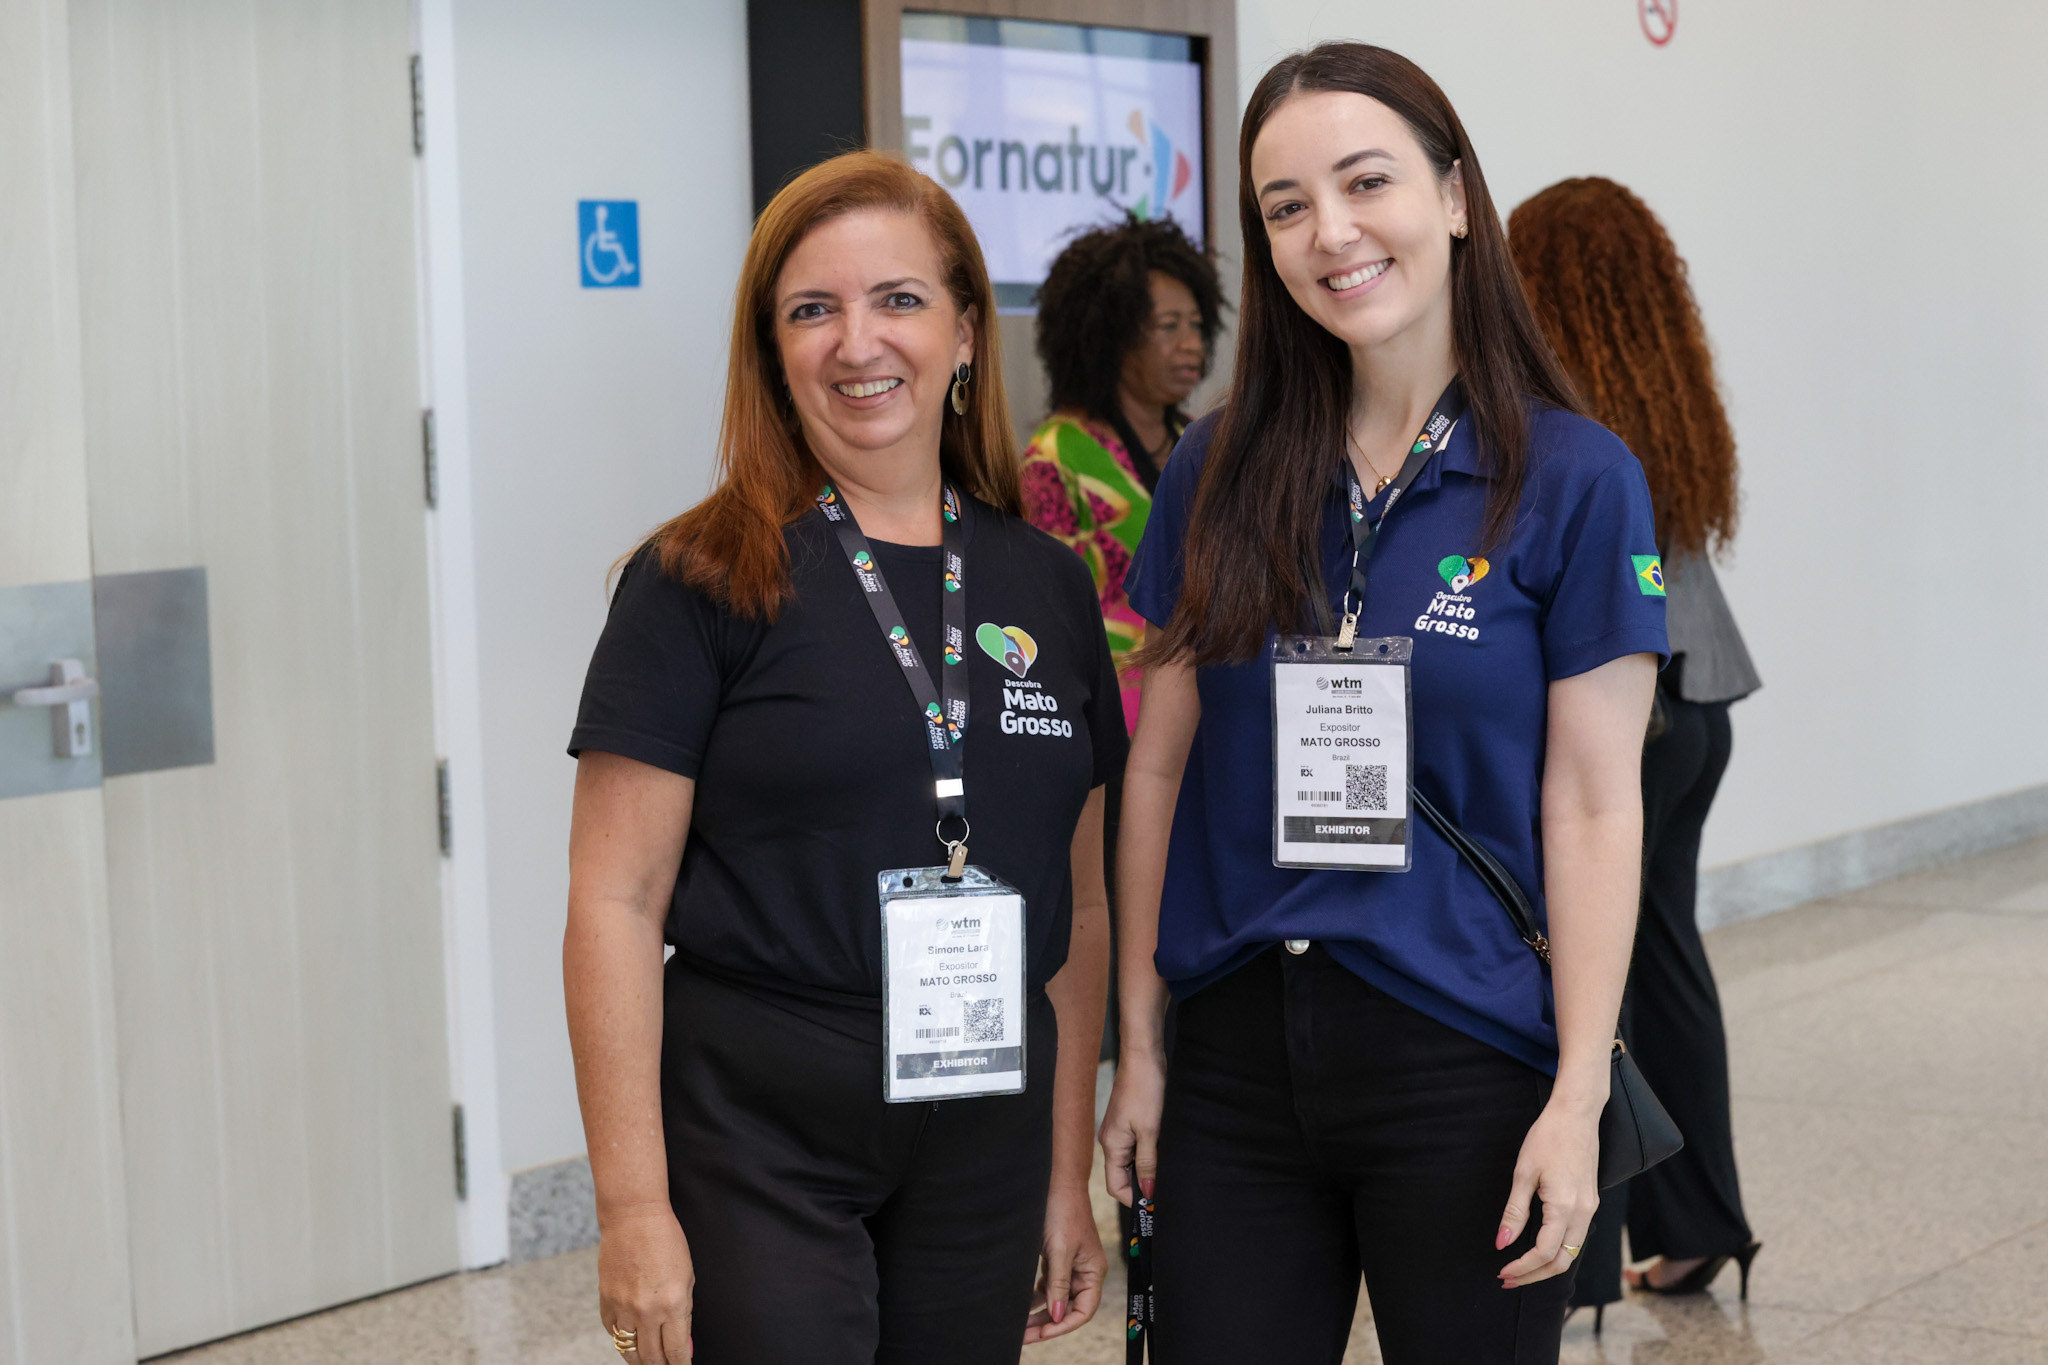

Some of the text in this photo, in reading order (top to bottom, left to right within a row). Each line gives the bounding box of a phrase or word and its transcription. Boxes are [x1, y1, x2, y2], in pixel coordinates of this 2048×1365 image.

[902, 114, 1138, 196] Fornatur
[1428, 414, 1446, 434] Mato
[1430, 418, 1450, 441] Grosso
[865, 573, 878, 592] Mato
[1435, 591, 1472, 603] Descubra
[1426, 598, 1476, 621] Mato
[949, 626, 957, 646] Mato
[1414, 614, 1480, 641] Grosso
[954, 629, 962, 653] Grosso
[893, 642, 908, 667] Grosso
[901, 648, 913, 667] Mato
[1005, 679, 1042, 689] Descubra
[1331, 676, 1362, 689] wtm
[951, 699, 960, 721] Mato
[1003, 688, 1058, 712] Mato
[1305, 704, 1373, 715] Juliana Britto
[957, 700, 966, 729] Grosso
[1000, 711, 1073, 738] Grosso
[928, 720, 939, 750] Grosso
[1320, 722, 1360, 733] Expositor
[935, 726, 945, 750] Mato
[1300, 737, 1381, 748] MATO GROSSO
[1315, 824, 1370, 835] EXHIBITOR
[951, 917, 981, 929] wtm
[927, 944, 989, 955] Simone Lara
[939, 961, 979, 972] Expositor
[920, 973, 998, 987] MATO GROSSO
[933, 1056, 988, 1069] EXHIBITOR
[1138, 1209, 1148, 1237] Grosso
[1132, 1294, 1140, 1316] Mato
